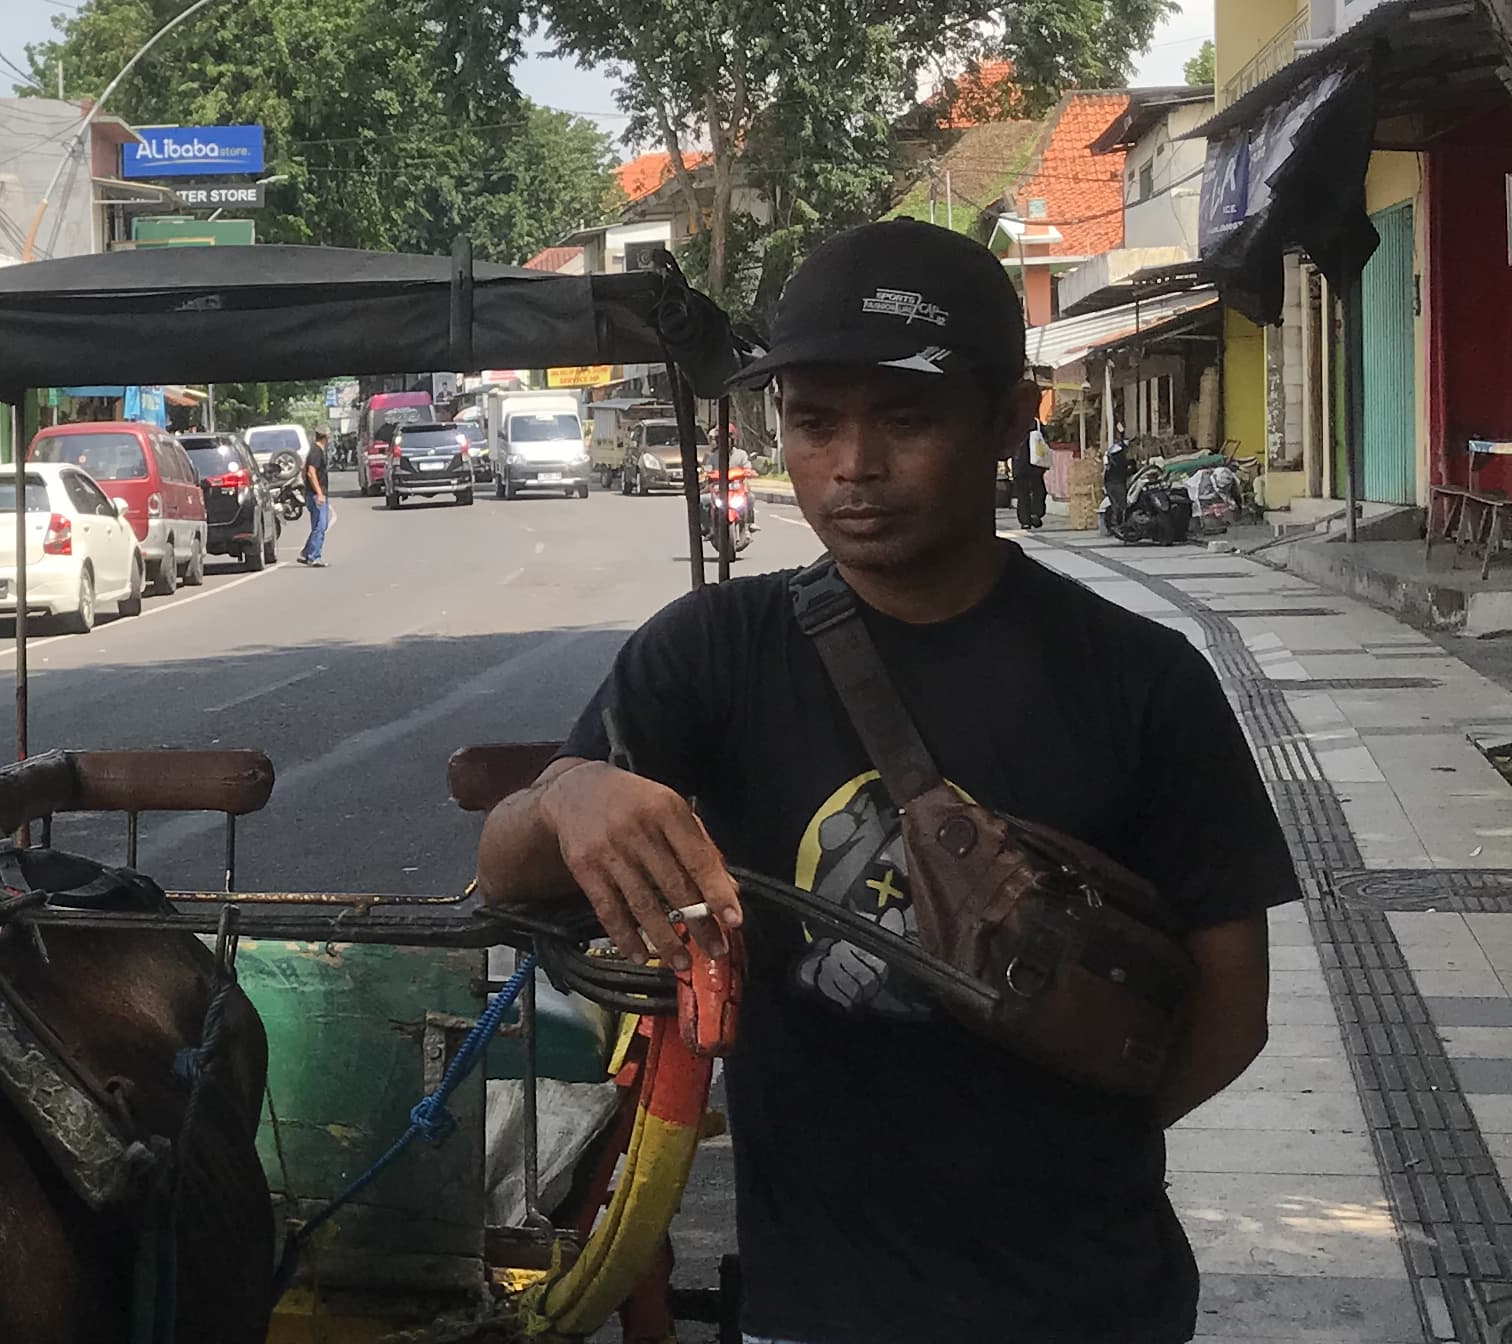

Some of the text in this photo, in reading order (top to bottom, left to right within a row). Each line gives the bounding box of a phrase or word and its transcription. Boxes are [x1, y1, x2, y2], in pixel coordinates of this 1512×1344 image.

[175, 189, 257, 203] TER STORE
[876, 292, 916, 304] SPORTS
